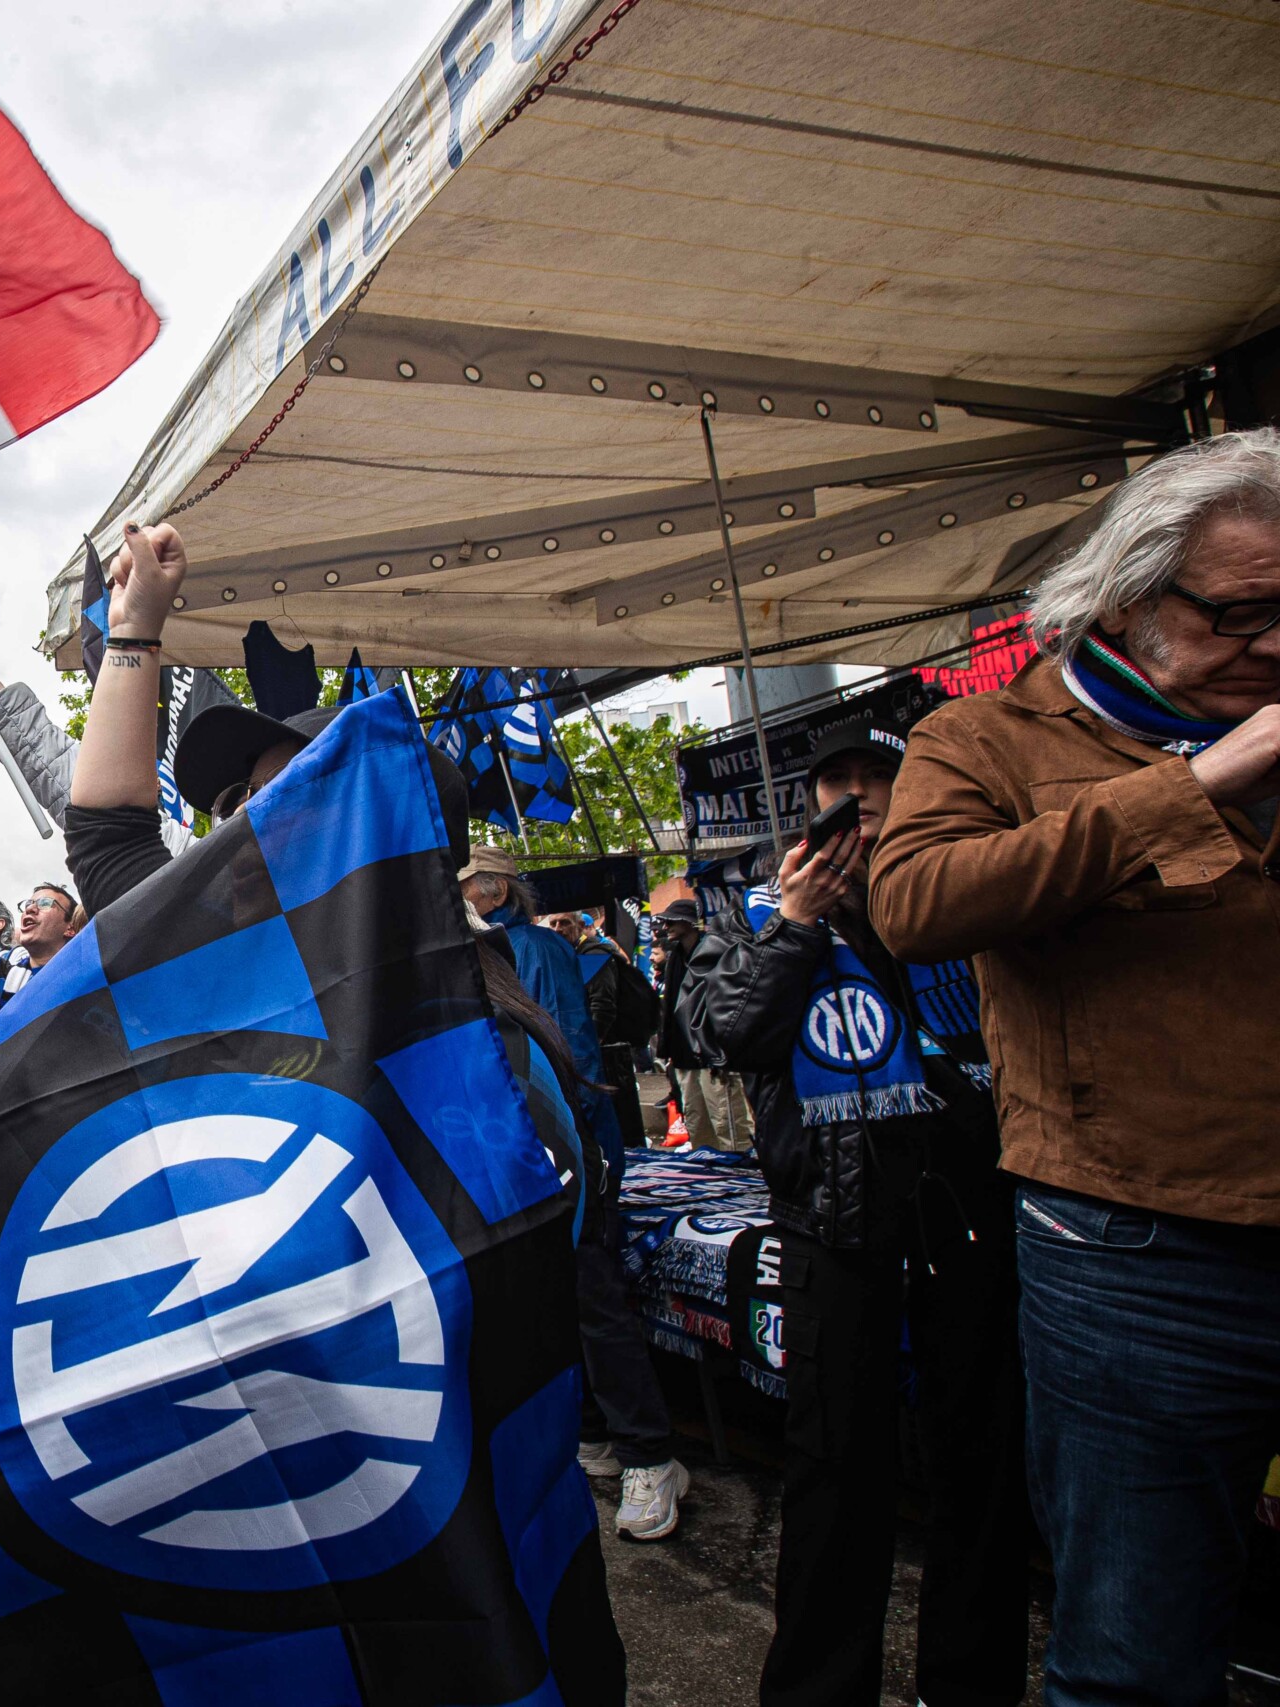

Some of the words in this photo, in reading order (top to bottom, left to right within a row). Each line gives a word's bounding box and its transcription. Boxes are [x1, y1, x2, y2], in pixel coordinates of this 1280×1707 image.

[276, 165, 400, 376] ALL
[870, 728, 906, 753] INTER
[696, 792, 748, 821] MAI
[756, 781, 808, 816] STA
